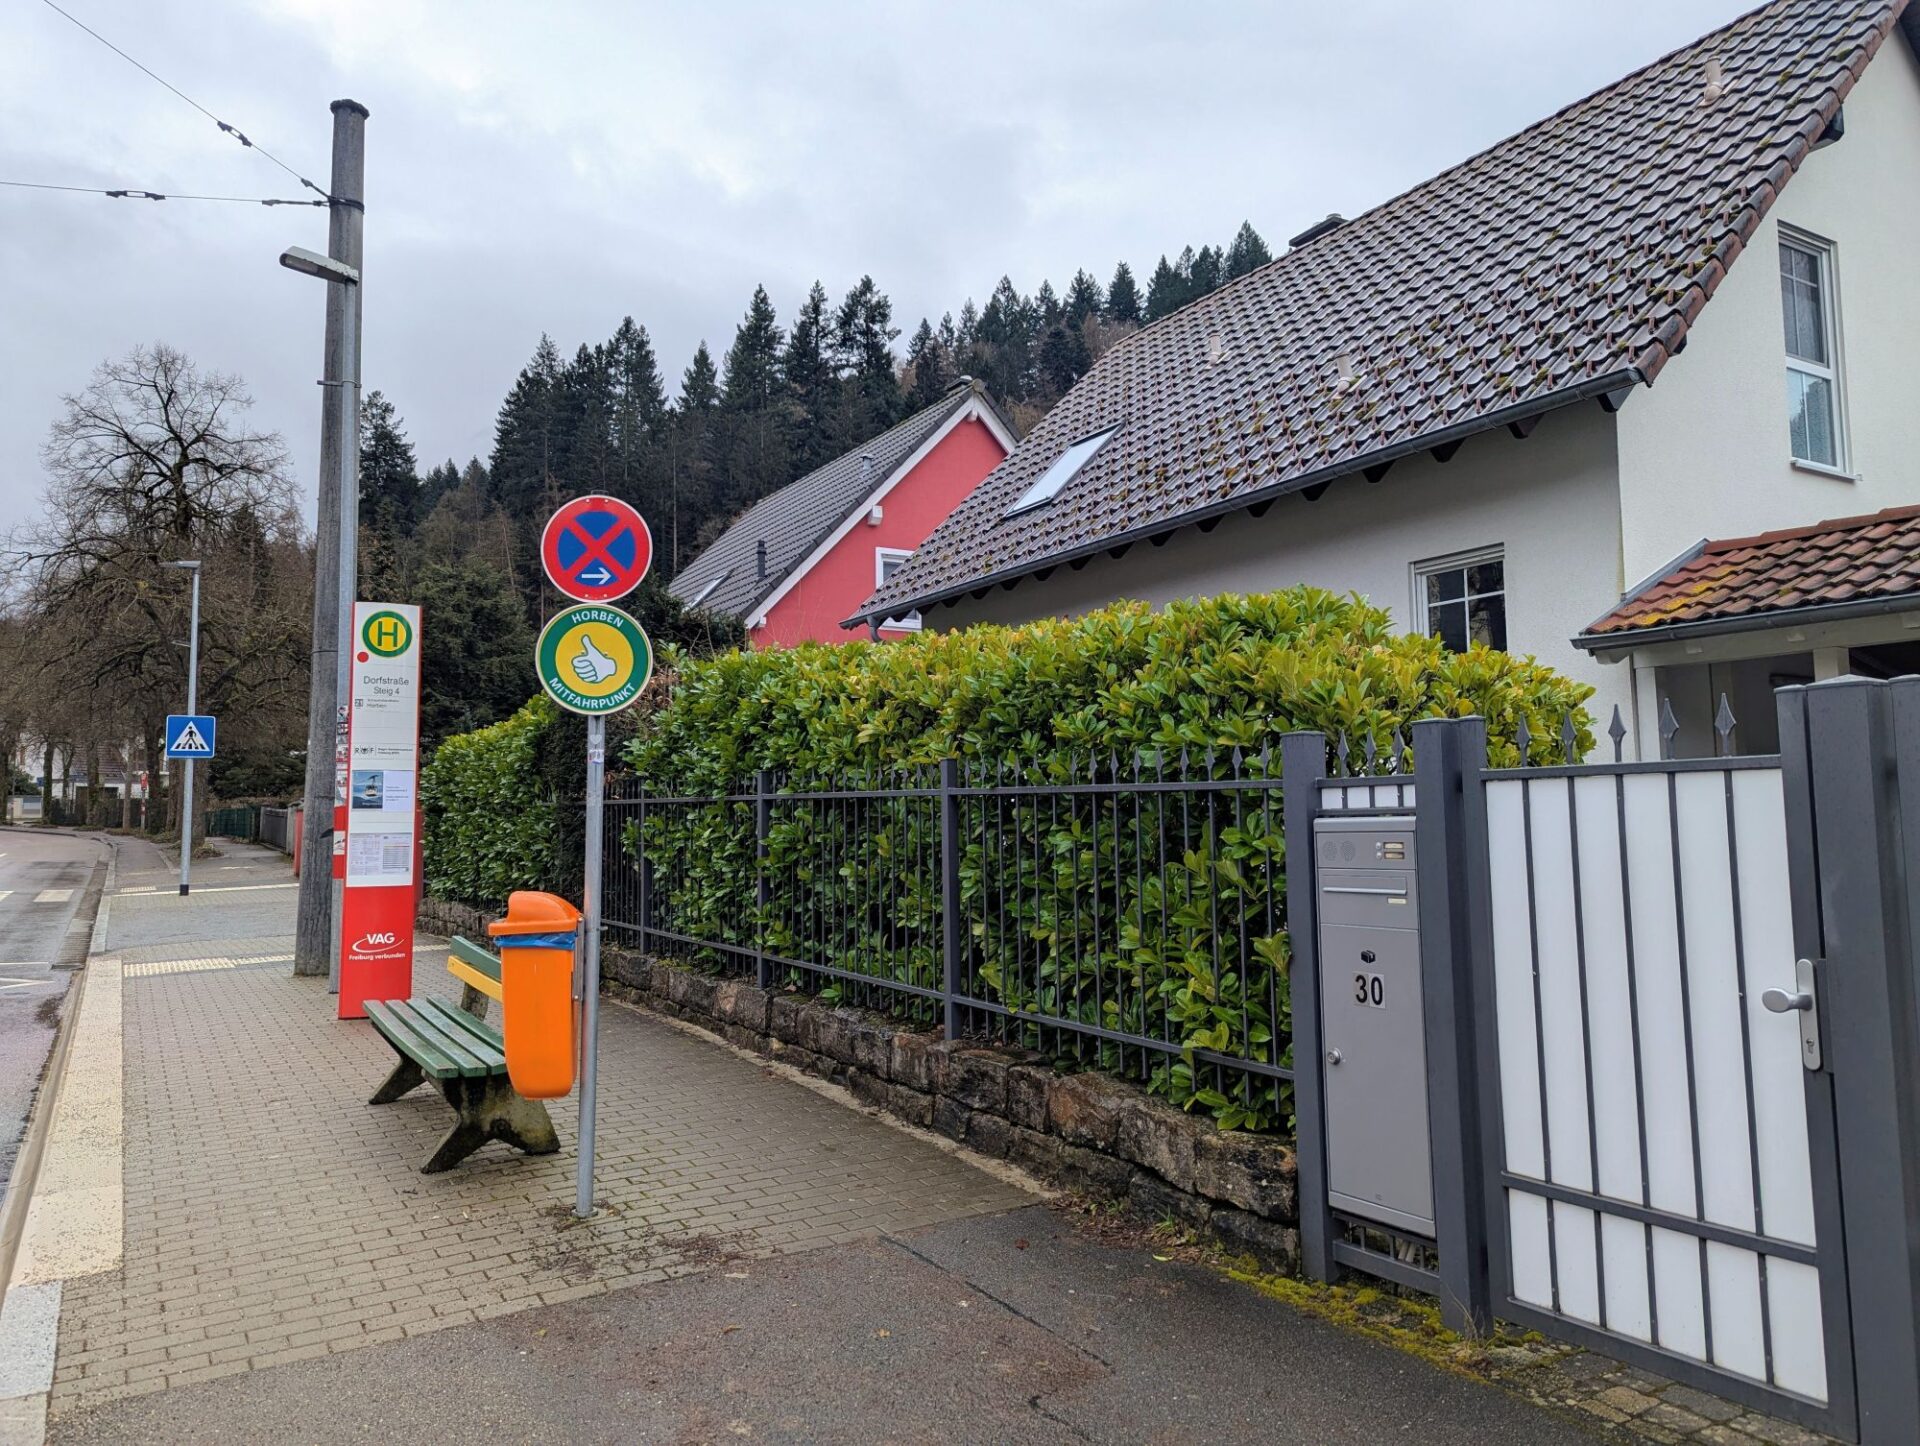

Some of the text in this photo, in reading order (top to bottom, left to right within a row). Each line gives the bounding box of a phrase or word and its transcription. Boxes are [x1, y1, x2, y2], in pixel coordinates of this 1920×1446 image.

[571, 610, 624, 628] HORBEN
[377, 621, 398, 648] H
[363, 675, 410, 686] Dorfstraße
[373, 687, 393, 696] Steig
[549, 677, 636, 709] MITFAHRPUNKT
[366, 932, 395, 944] VAG
[1355, 974, 1384, 1006] 30
